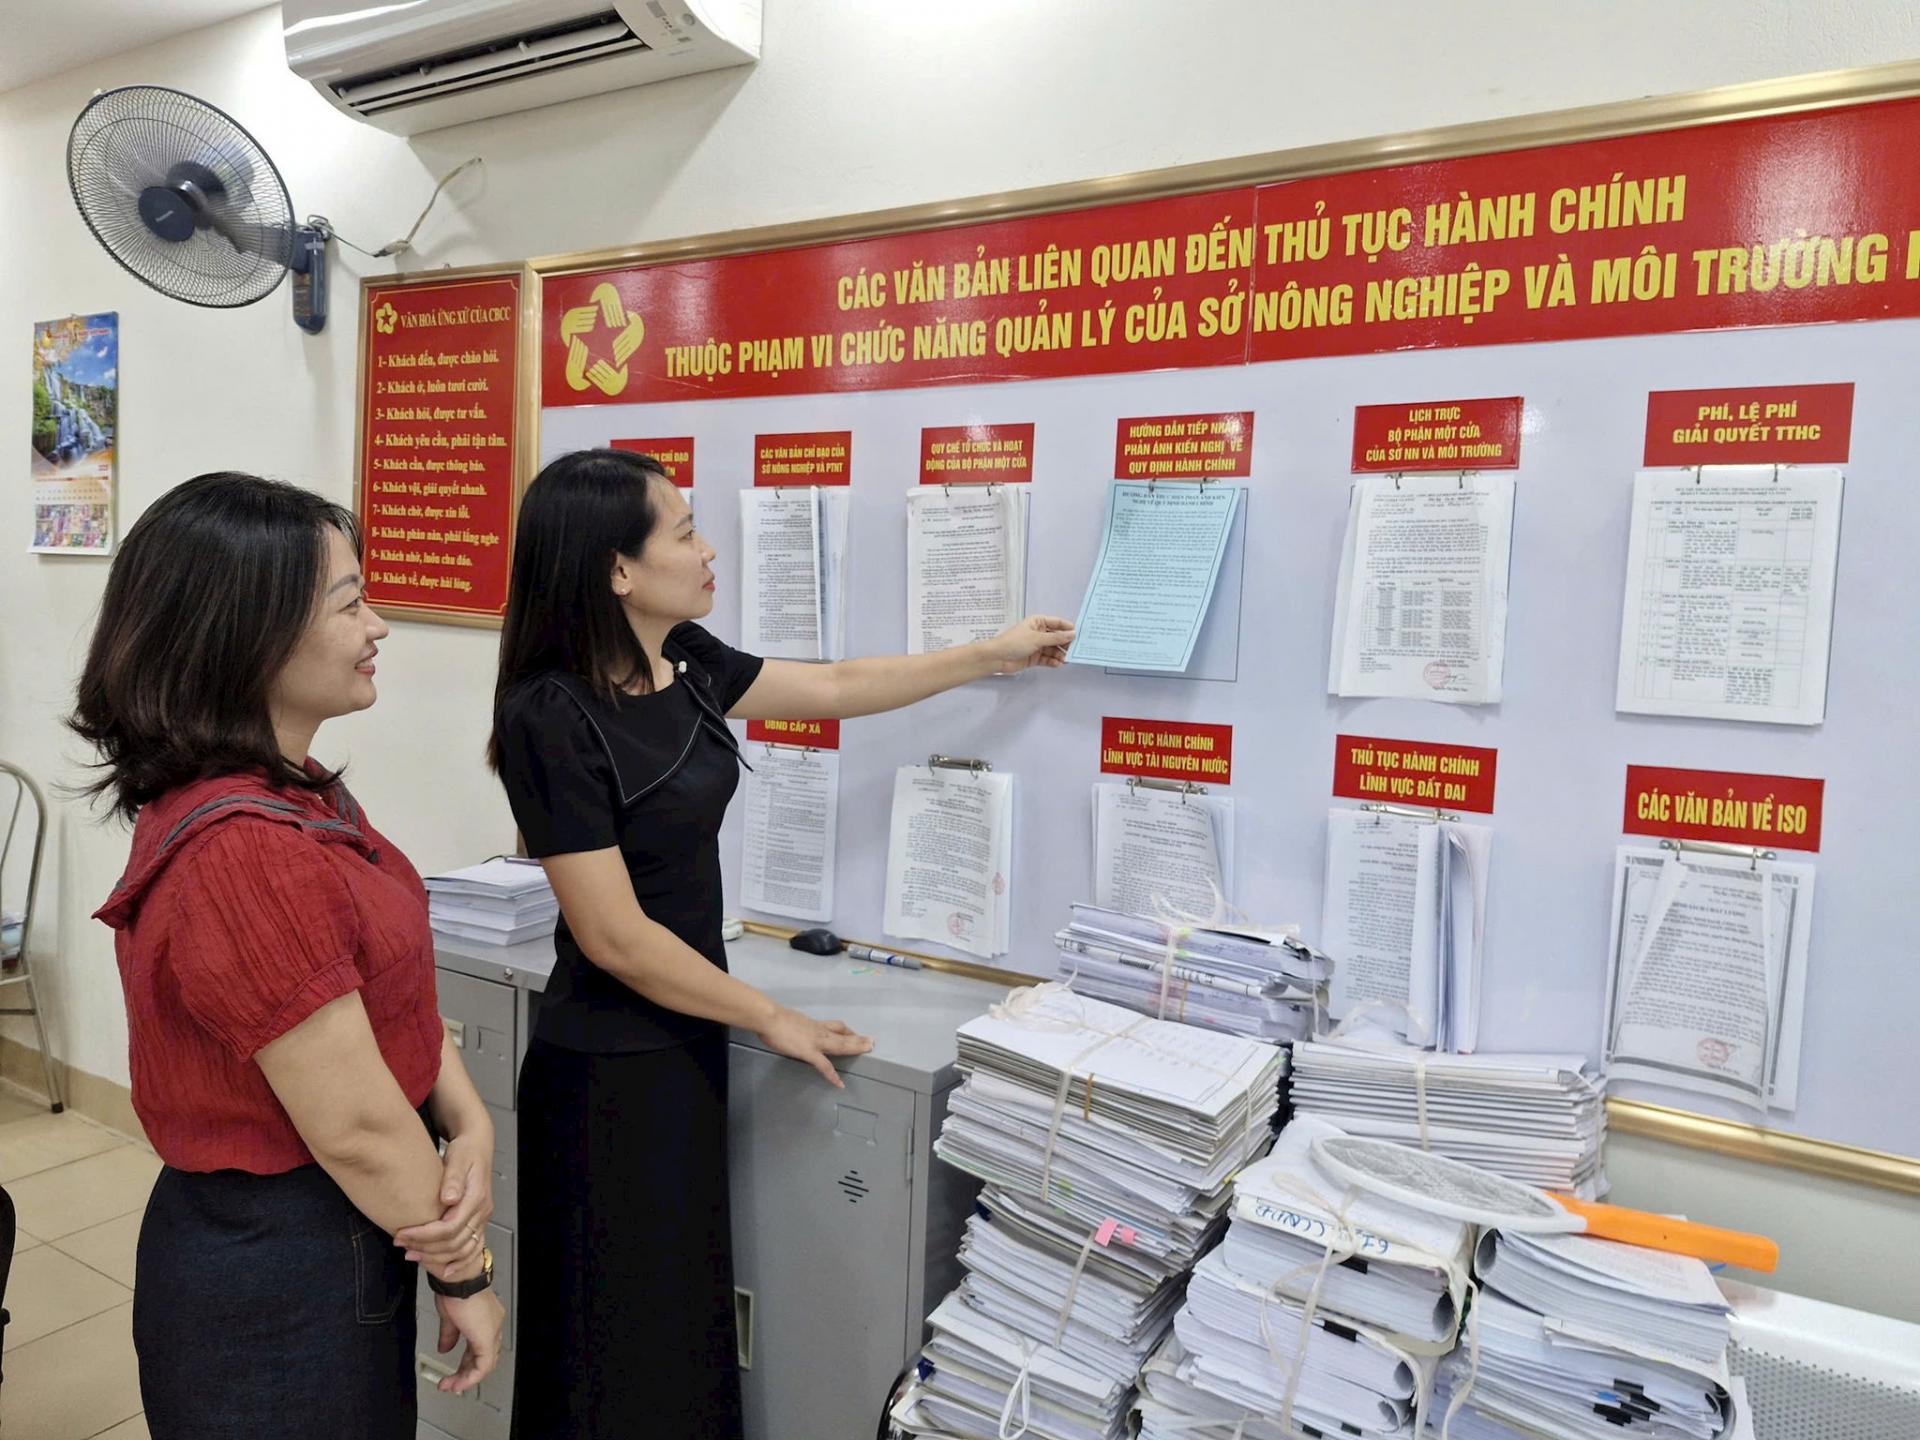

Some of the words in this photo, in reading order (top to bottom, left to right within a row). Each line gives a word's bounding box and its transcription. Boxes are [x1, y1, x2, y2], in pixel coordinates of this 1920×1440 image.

[837, 267, 886, 311] CÁC
[894, 260, 946, 304] VĂN
[954, 245, 1009, 300] BẢN
[1018, 244, 1082, 293] LIÊN
[1090, 237, 1176, 288] QUAN
[1185, 215, 1252, 274] ĐẾN
[1264, 200, 1330, 265] THỦ
[1342, 208, 1411, 263] TỤC
[1424, 192, 1536, 248] HÀNH
[1549, 172, 1686, 234] CHÍNH
[665, 337, 731, 382] THUỘC
[739, 336, 804, 378] PHẠM
[811, 335, 832, 368] VI
[840, 319, 905, 366] CHỨC
[913, 316, 986, 359] NĂNG
[995, 298, 1073, 357] QUẢN
[1081, 300, 1117, 347] LÝ
[1125, 286, 1187, 344] CỦA
[1198, 278, 1245, 337] SỞ
[1253, 281, 1353, 332] NÔNG
[1365, 262, 1510, 324] NGHIỆP
[1524, 253, 1577, 310] VÀ
[1591, 245, 1677, 305] MÔI
[1692, 227, 1889, 296] TRƯỜNG
[1409, 408, 1431, 424] LỊCH
[1435, 406, 1461, 423] TRỰC
[1698, 403, 1733, 421] PHÍ,
[1739, 402, 1760, 422] LỆ
[1765, 400, 1797, 418] PHÍ
[1129, 423, 1162, 438] HƯỚNG
[1164, 420, 1184, 436] DẪN
[1187, 419, 1208, 435] TIẾP
[1388, 427, 1401, 446] BỘ
[1404, 426, 1431, 443] PHẬN
[1435, 424, 1457, 442] MỘT
[1459, 421, 1480, 438] CỬA
[1673, 423, 1708, 443] GIẢI
[1714, 422, 1770, 444] QUYẾT
[1775, 425, 1821, 441] TTHC
[761, 447, 773, 459] CÁC
[774, 447, 787, 458] VĂN
[789, 444, 802, 458] BẢN
[804, 444, 816, 457] CHỈ
[816, 447, 830, 460] ĐẠO
[831, 442, 845, 457] CỦA
[1124, 439, 1150, 456] PHẢN
[1152, 441, 1172, 454] ÁNH
[1175, 438, 1198, 454] KIẾN
[1200, 440, 1225, 455] NGHỊ
[1366, 444, 1385, 462] CỦA
[1388, 445, 1402, 461] SỞ
[1404, 448, 1419, 460] NN
[1422, 445, 1435, 459] VÀ
[1437, 443, 1457, 458] MÔI
[1461, 442, 1502, 457] TRƯỜNG
[761, 460, 771, 474] SỞ
[772, 462, 790, 473] NÔNG
[791, 461, 815, 475] NGHIỆP
[816, 461, 825, 472] VÀ
[826, 462, 843, 472] PTNT
[1129, 461, 1148, 474] QUY
[1149, 460, 1172, 475] ĐỊNH
[1175, 458, 1202, 471] HÀNH
[1204, 457, 1236, 471] CHÍNH
[1118, 726, 1135, 745] THỦ
[1137, 732, 1154, 748] TỤC
[1157, 731, 1182, 748] HÀNH
[1184, 734, 1214, 751] CHÍNH
[1104, 748, 1123, 764] LĨNH
[1126, 751, 1143, 768] VỰC
[1145, 752, 1160, 768] TÀI
[1162, 754, 1199, 771] NGUYÊN
[1201, 756, 1228, 774] NƯỚC
[1351, 743, 1374, 766] THỦ
[1377, 750, 1399, 771] TỤC
[1402, 751, 1437, 772] HÀNH
[1440, 755, 1480, 776] CHÍNH
[1360, 772, 1387, 793] LĨNH
[1390, 777, 1414, 798] VỰC
[1417, 776, 1441, 798] ĐẤT
[1444, 783, 1466, 801] ĐAI
[1637, 788, 1670, 821] CÁC
[1675, 791, 1708, 825] VĂN
[1712, 788, 1747, 829] BẢN
[1752, 793, 1775, 831] VỀ
[1777, 804, 1807, 834] ISO
